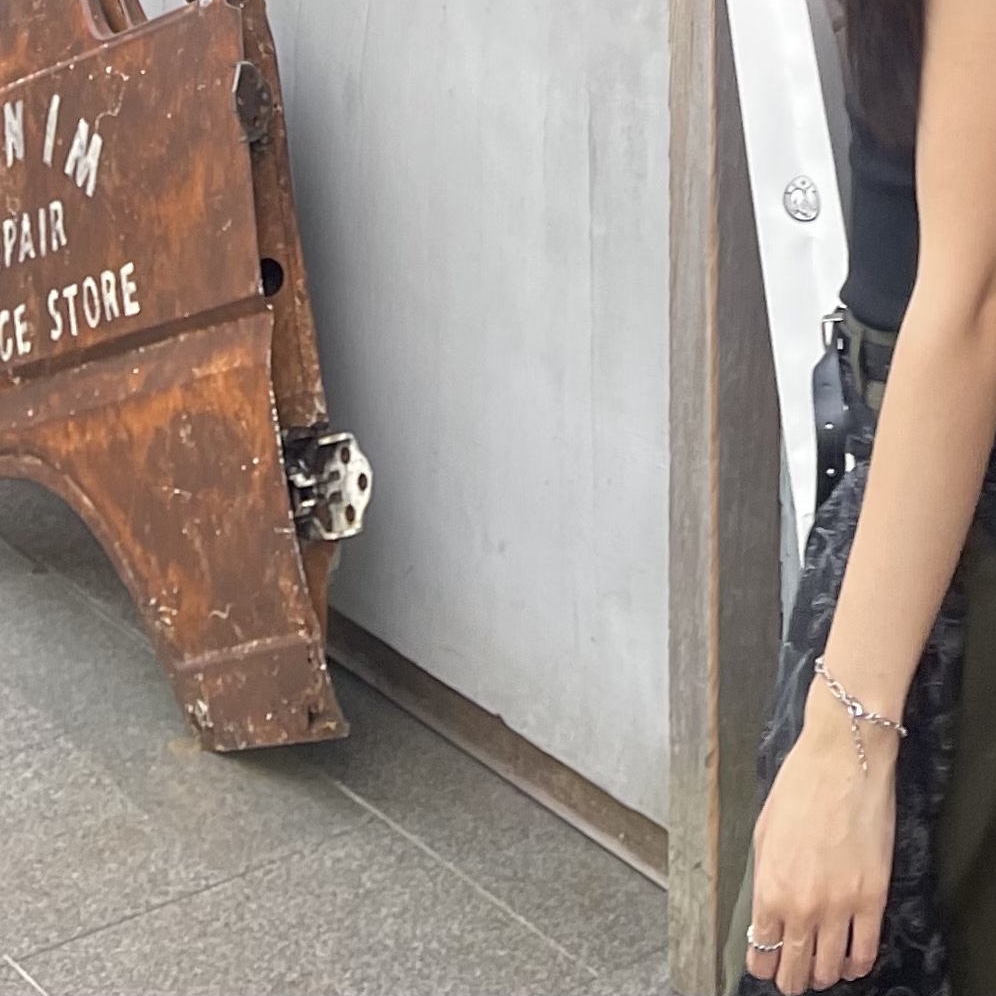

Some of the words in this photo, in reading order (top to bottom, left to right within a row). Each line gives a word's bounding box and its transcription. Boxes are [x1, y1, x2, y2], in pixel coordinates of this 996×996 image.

[3, 93, 103, 197] NIM
[2, 200, 67, 268] PAIR
[47, 261, 141, 341] STORE
